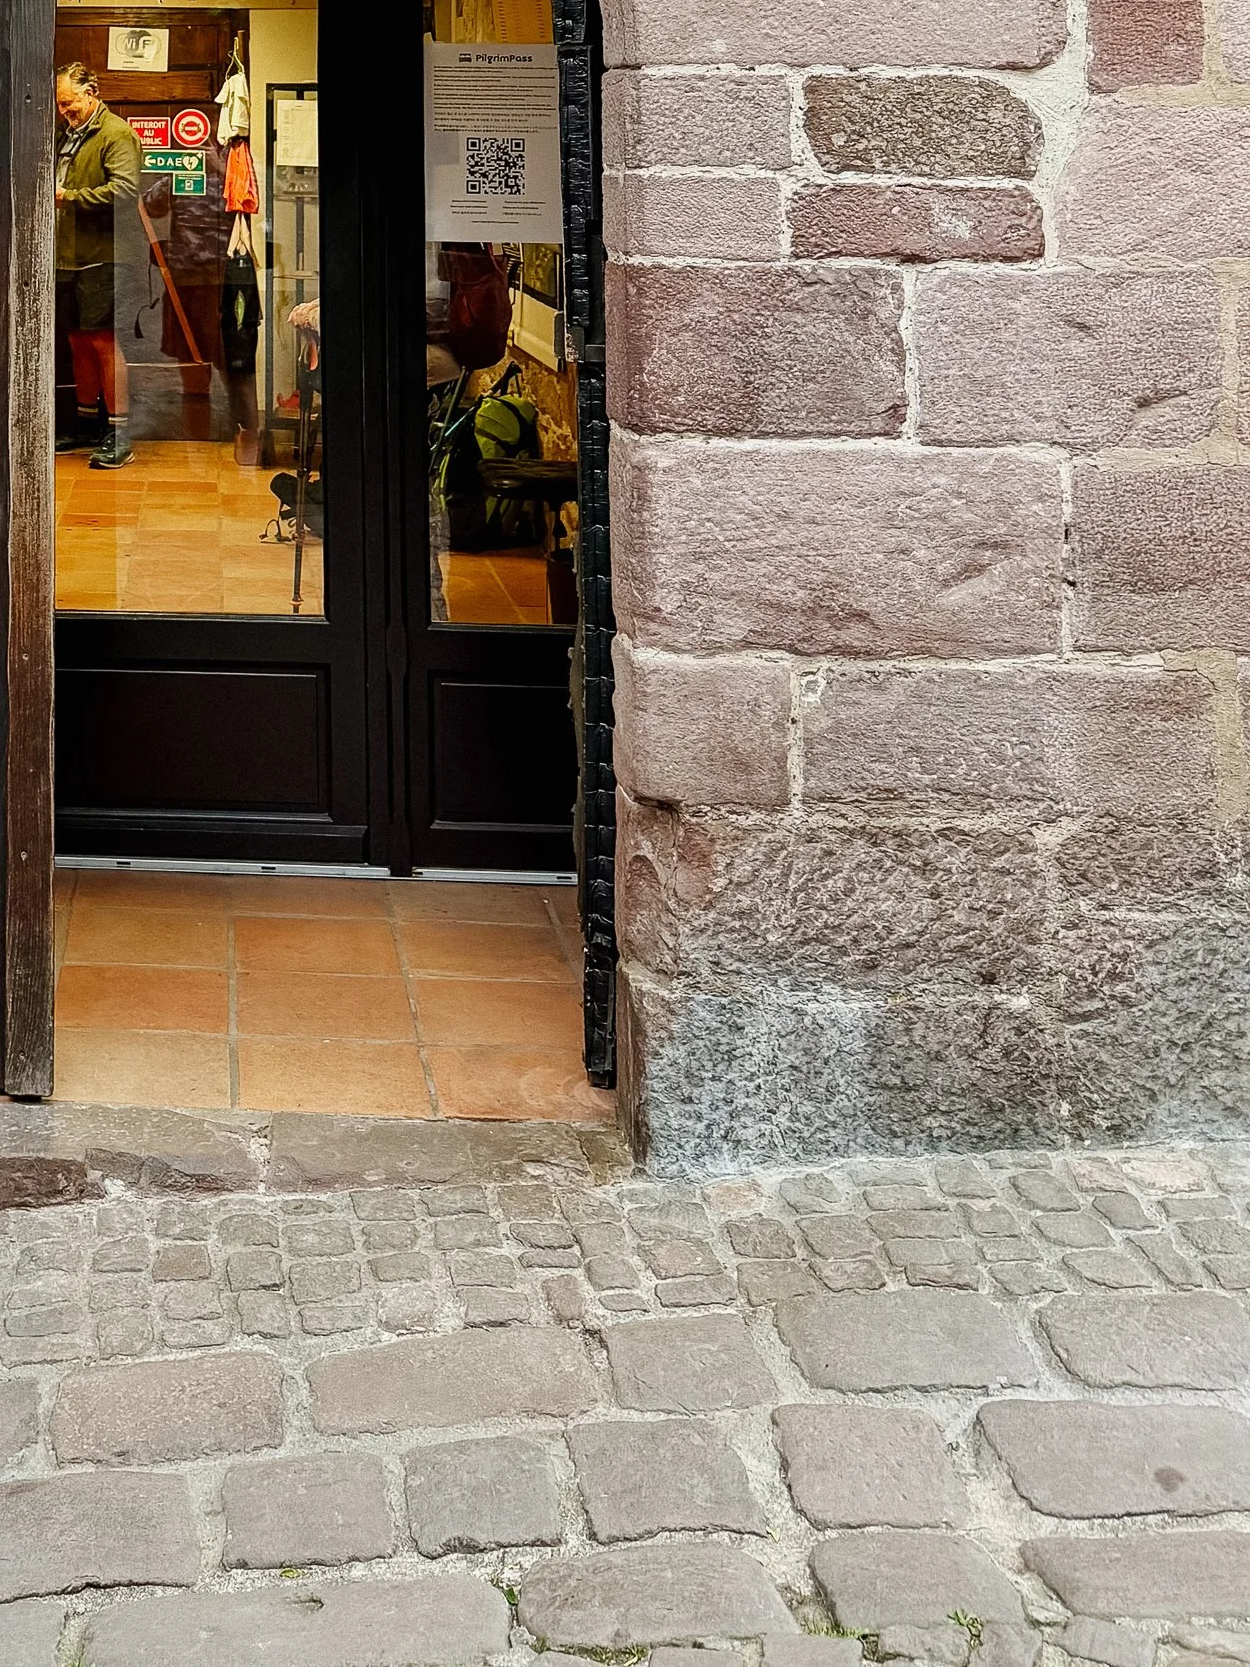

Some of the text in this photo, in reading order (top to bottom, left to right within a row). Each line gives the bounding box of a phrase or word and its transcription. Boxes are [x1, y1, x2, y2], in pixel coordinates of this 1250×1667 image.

[475, 53, 533, 64] PilgrimPass
[132, 121, 167, 129] INTERDIT
[143, 129, 155, 137] AU
[139, 137, 163, 145] UBLIC
[157, 157, 183, 167] DAE
